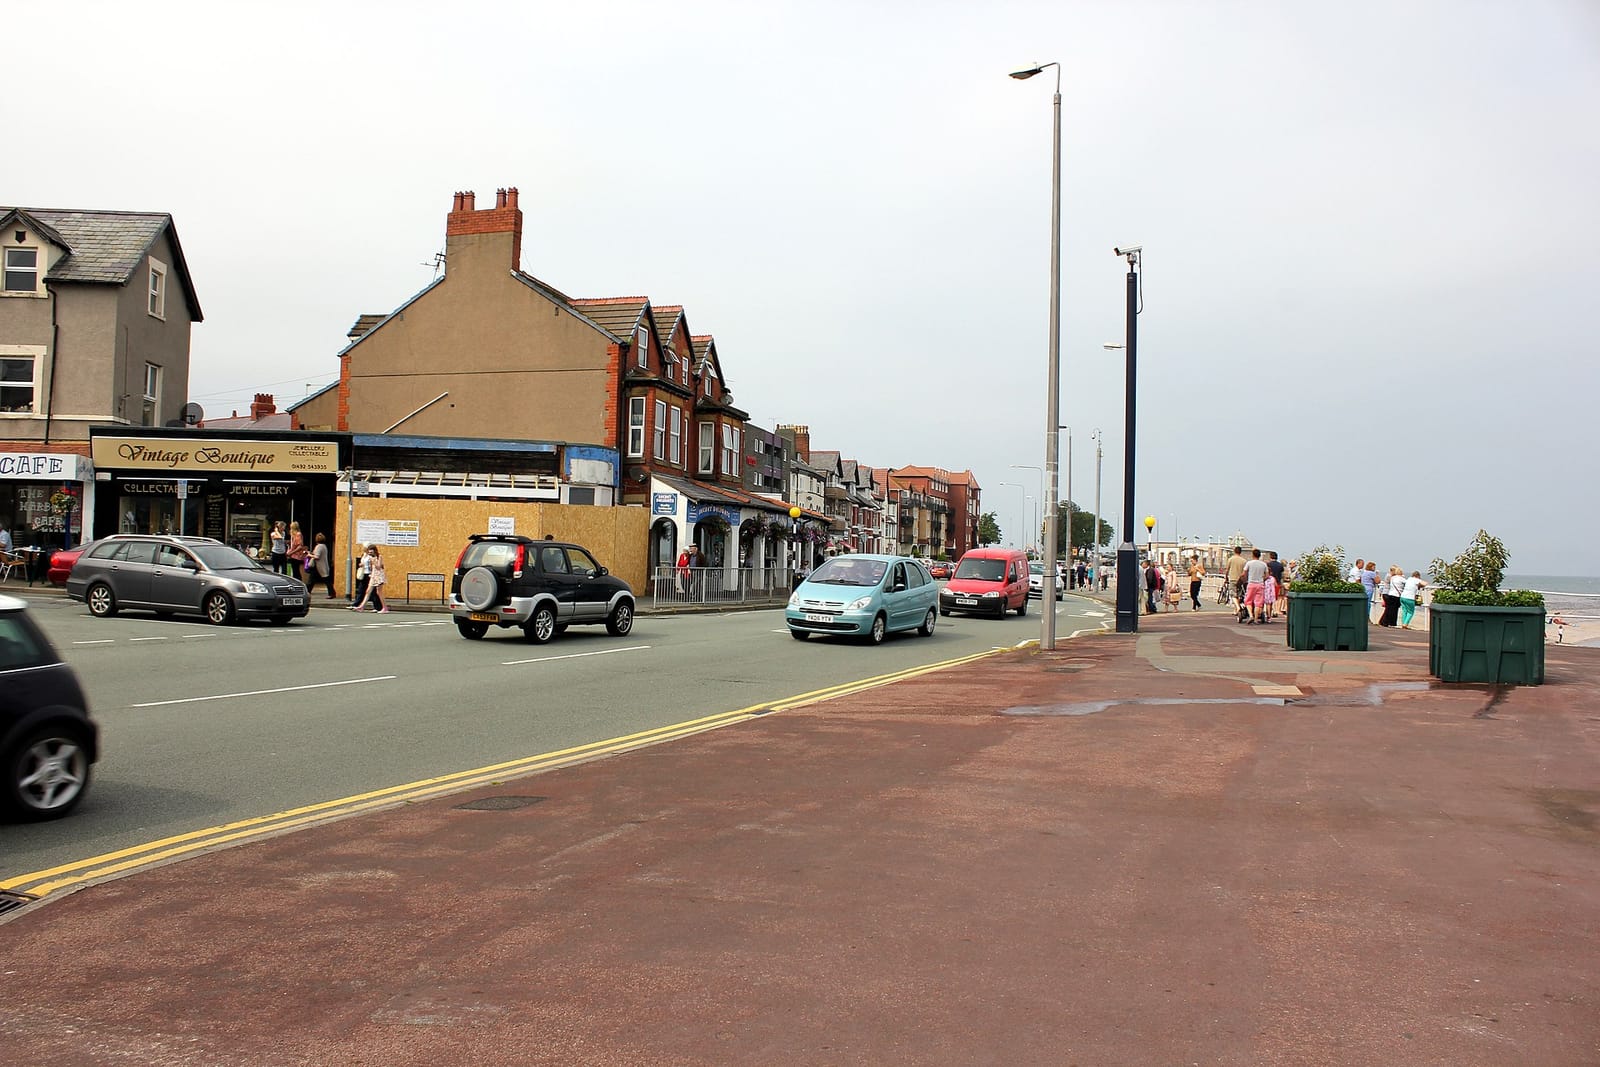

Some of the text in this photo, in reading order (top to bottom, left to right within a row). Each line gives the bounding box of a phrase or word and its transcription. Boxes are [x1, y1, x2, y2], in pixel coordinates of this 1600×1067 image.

[118, 443, 275, 469] Vintage Boutique
[0, 455, 63, 475] CAFE
[18, 488, 44, 498] THE
[123, 483, 201, 494] COLLECTABES
[229, 486, 289, 495] JEWELLERY
